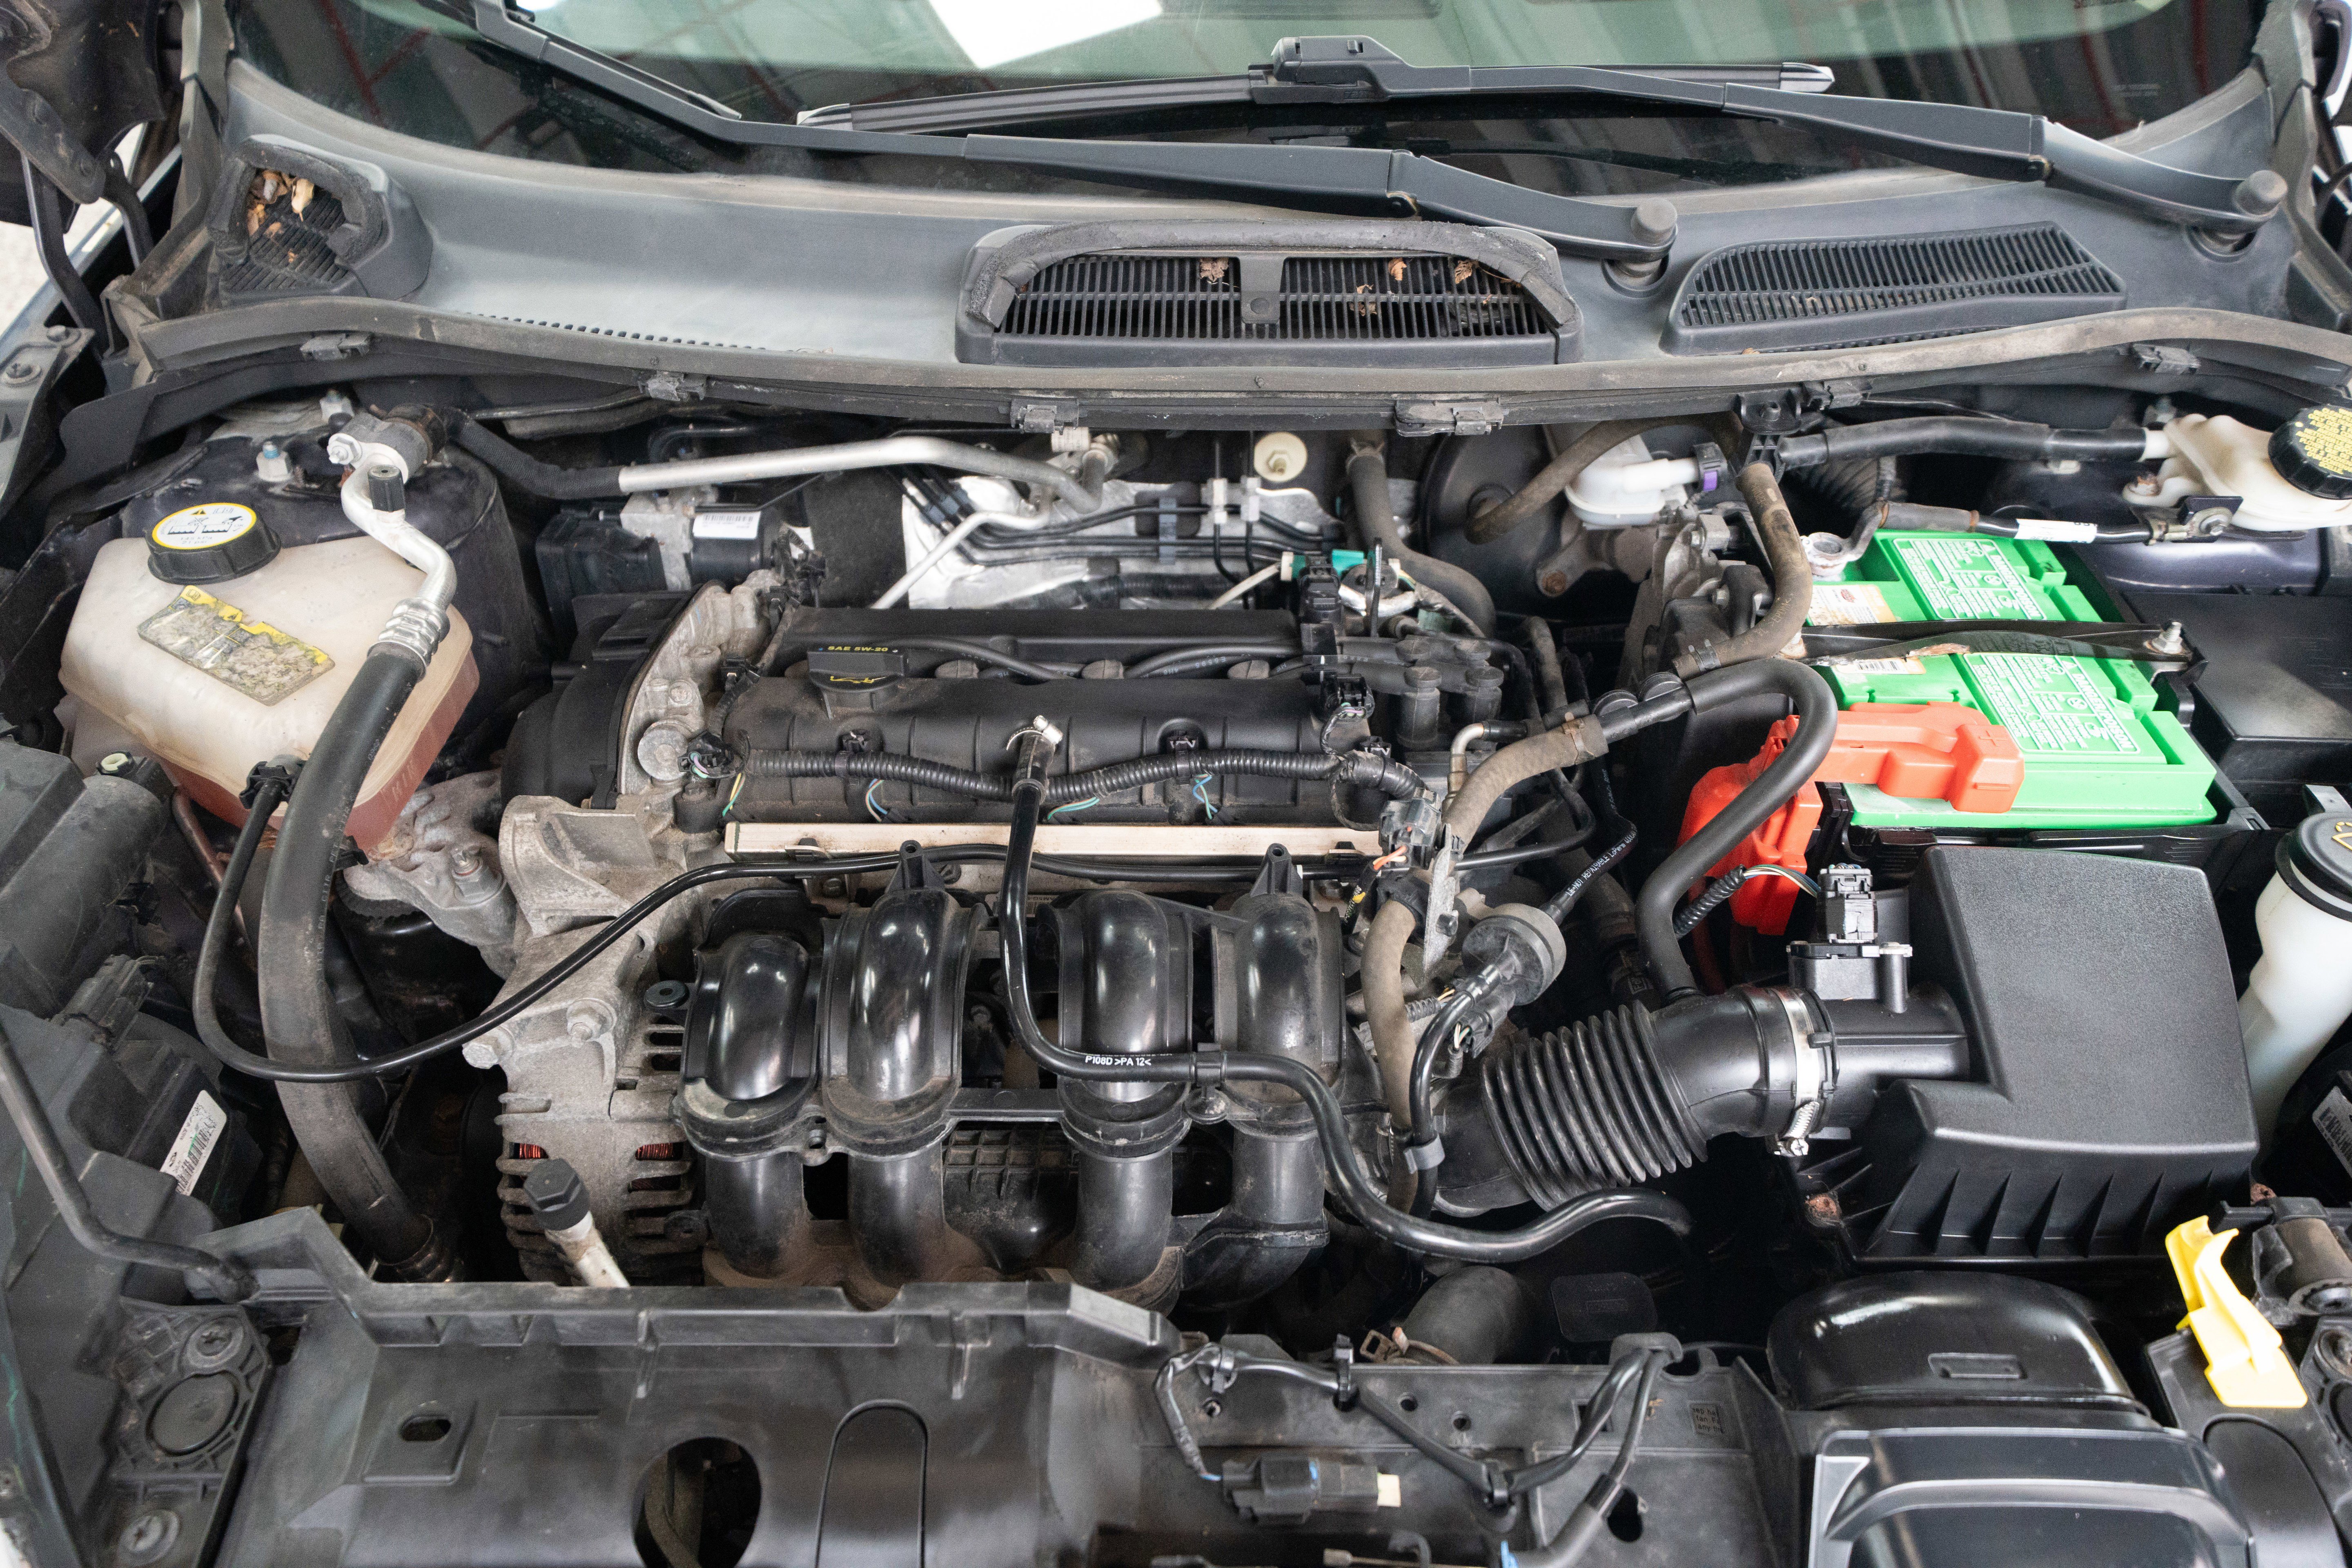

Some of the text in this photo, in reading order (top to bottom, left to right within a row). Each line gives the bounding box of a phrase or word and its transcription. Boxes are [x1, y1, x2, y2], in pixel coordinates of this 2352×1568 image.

[1990, 554, 2042, 618] DANGER/POISON
[2071, 673, 2134, 748] DANGER/POISON
[1581, 855, 1610, 880] REPAIRABLE
[1085, 1055, 1152, 1066] P108D >PA 12<
